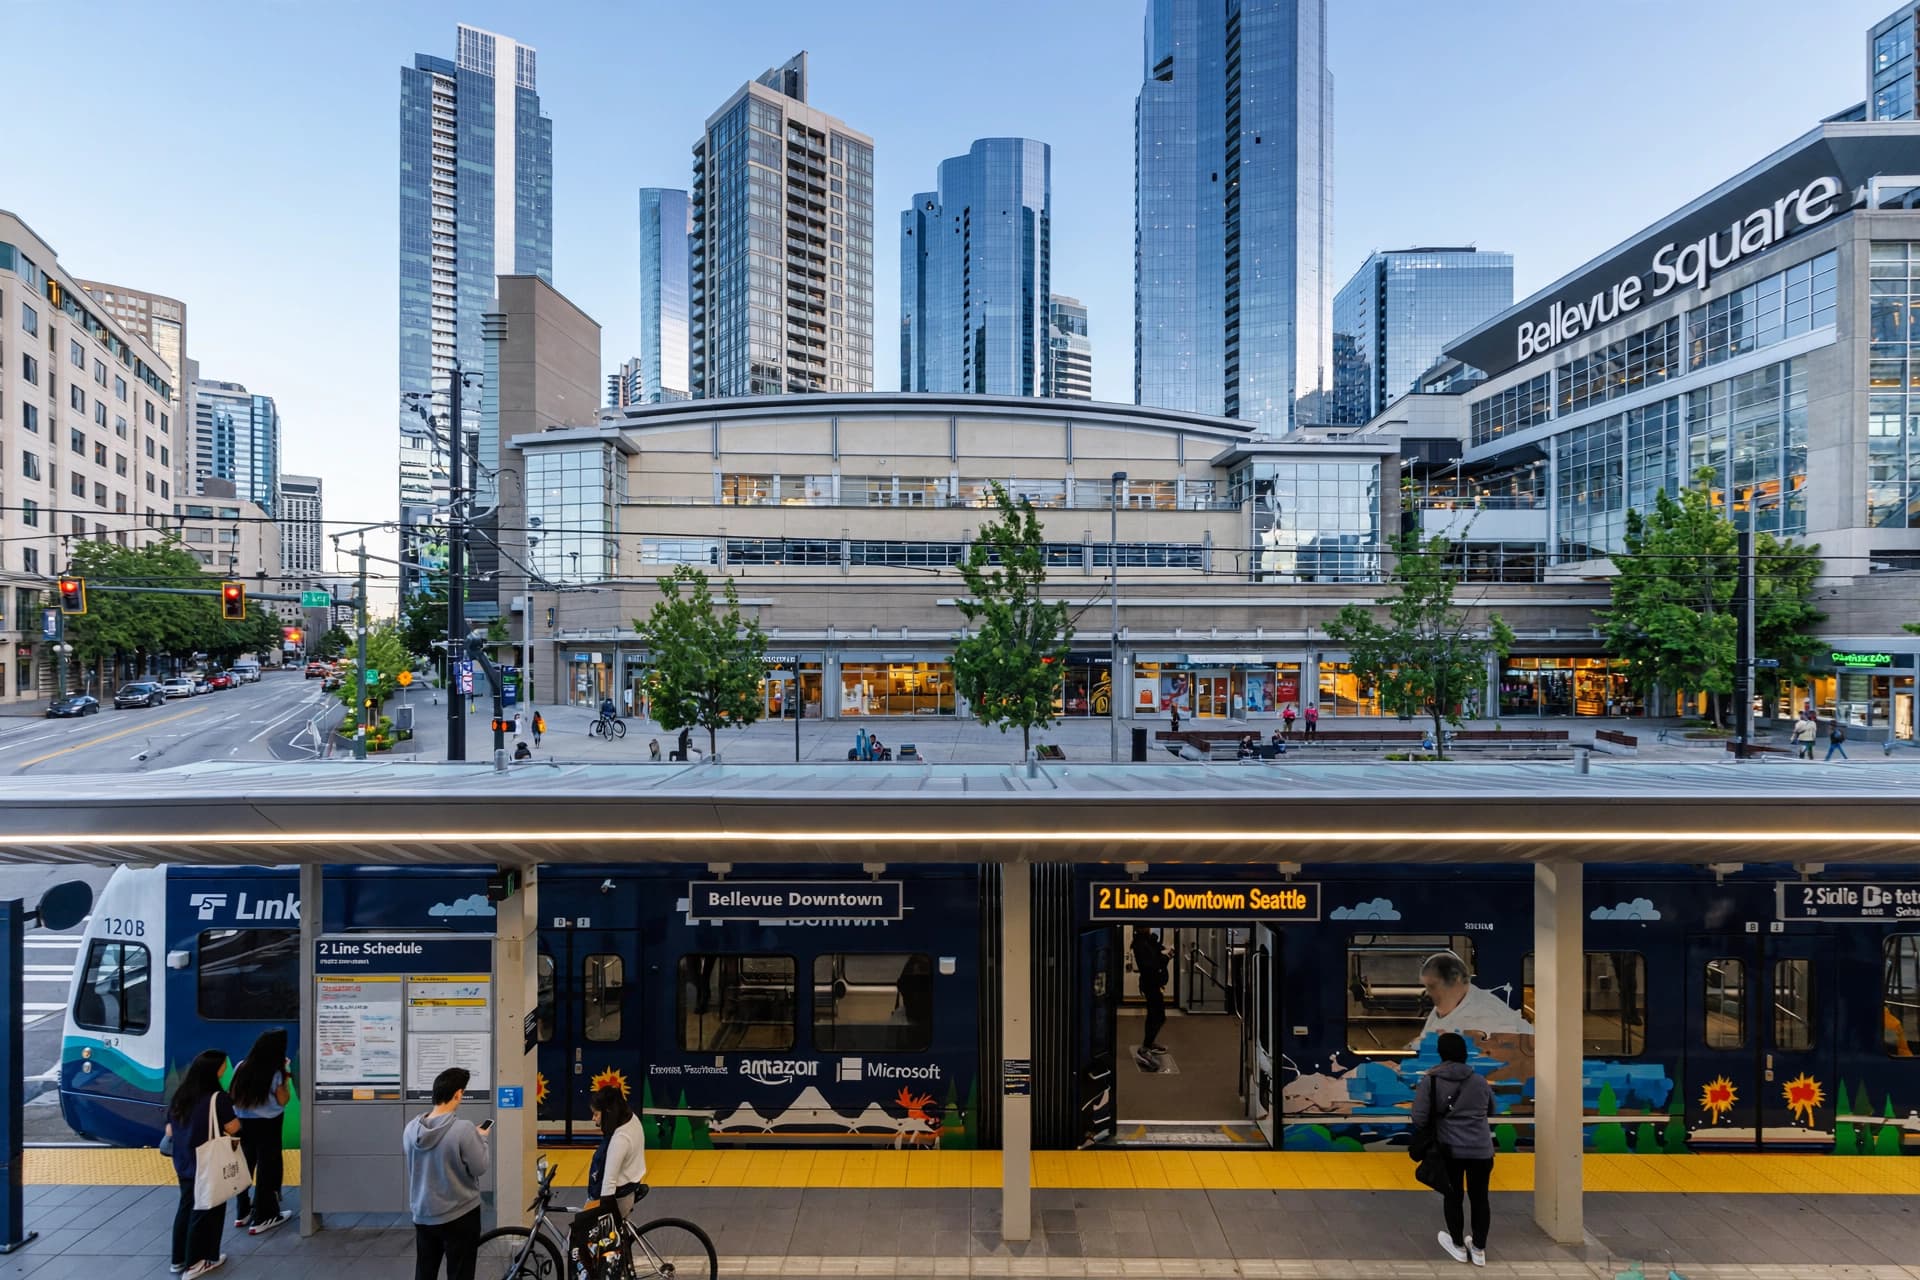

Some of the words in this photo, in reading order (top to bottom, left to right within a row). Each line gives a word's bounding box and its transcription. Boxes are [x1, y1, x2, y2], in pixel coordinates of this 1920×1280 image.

[1517, 275, 1643, 363] Bellevue
[1652, 175, 1842, 297] Square
[708, 891, 784, 906] Bellevue
[788, 892, 884, 906] Downtown
[1099, 888, 1111, 909] 2
[1115, 888, 1149, 910] Line
[1163, 888, 1245, 910] Downtown
[1249, 888, 1307, 910] Seattle
[1803, 887, 1813, 905] 2
[235, 892, 302, 920] Link
[104, 917, 146, 937] 120B
[319, 942, 329, 955] 2
[332, 942, 360, 955] Line
[362, 941, 423, 955] Schedule
[739, 1058, 819, 1077] amazon
[867, 1062, 942, 1080] Microsoft
